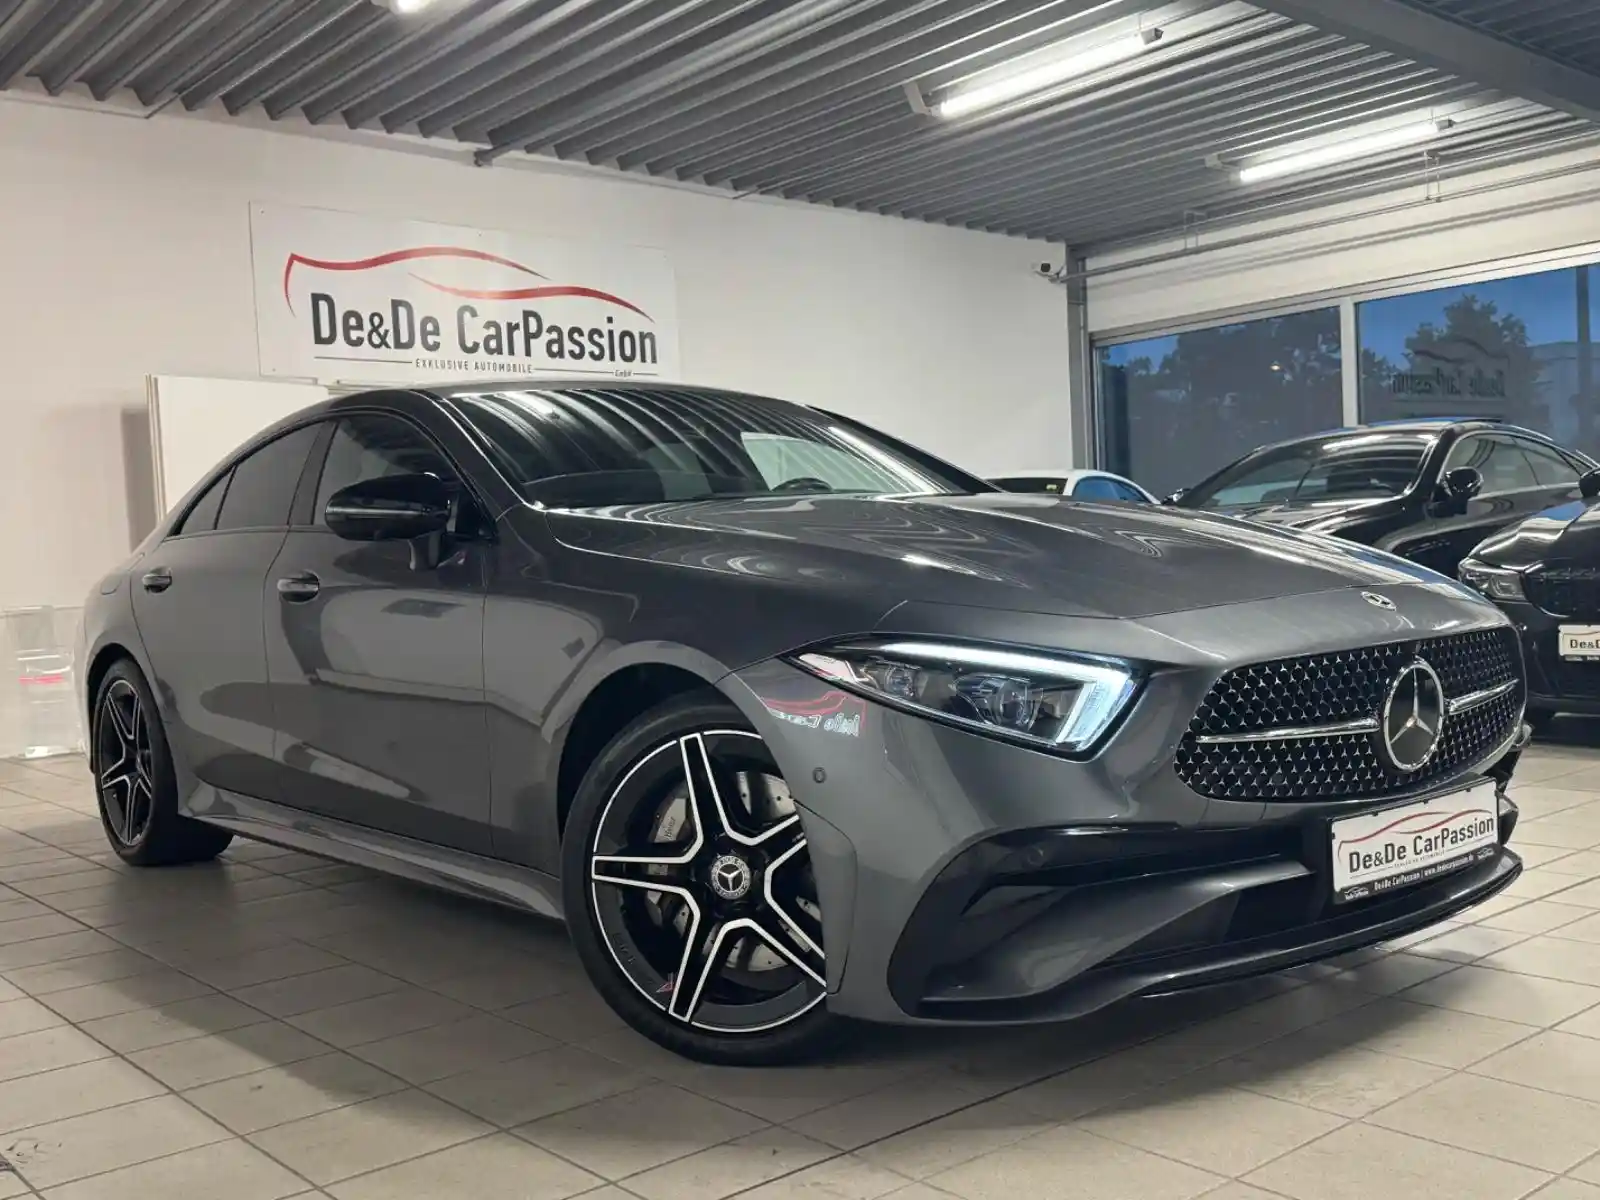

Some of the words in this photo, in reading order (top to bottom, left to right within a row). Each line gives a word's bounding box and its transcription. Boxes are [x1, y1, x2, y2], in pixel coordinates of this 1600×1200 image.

[310, 292, 441, 351] De&De
[456, 304, 658, 364] CarPassion
[415, 358, 469, 371] EXKLUSIVE
[474, 361, 533, 374] AUTOMOBILE
[1349, 843, 1407, 873] De&De
[1413, 817, 1494, 856] CarPassion
